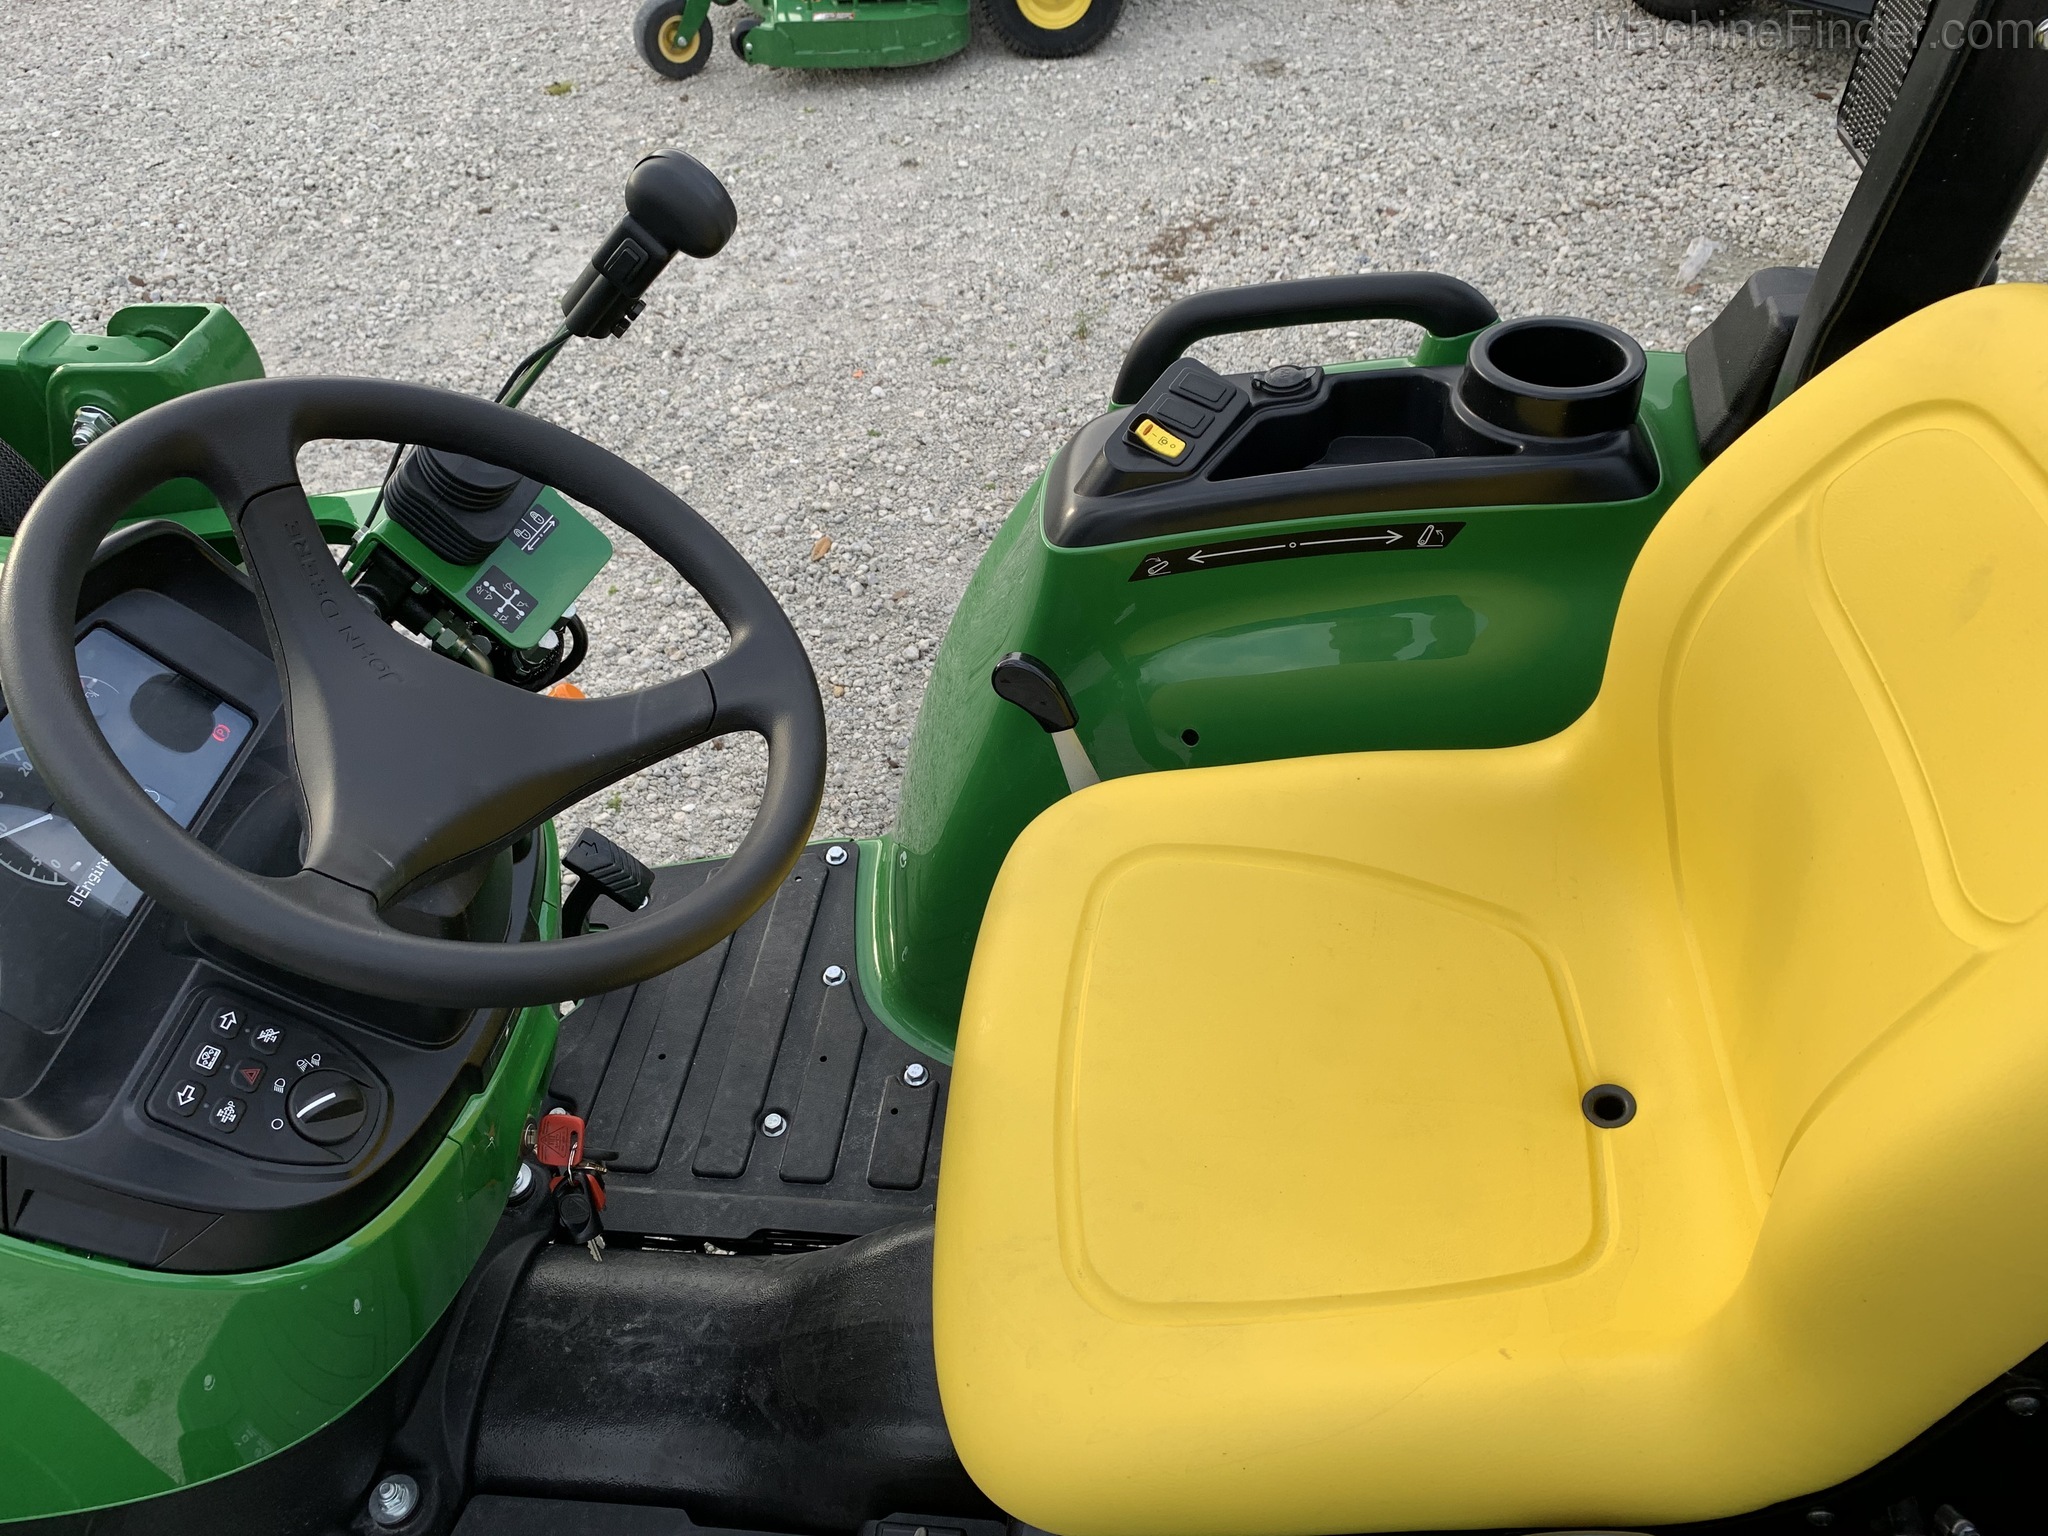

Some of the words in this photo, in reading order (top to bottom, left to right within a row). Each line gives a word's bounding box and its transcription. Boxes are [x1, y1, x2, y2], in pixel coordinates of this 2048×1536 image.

[284, 519, 340, 620] DEERE
[337, 625, 406, 684] JOHN
[18, 761, 33, 778] 20
[31, 856, 43, 867] 5
[50, 859, 61, 870] 0
